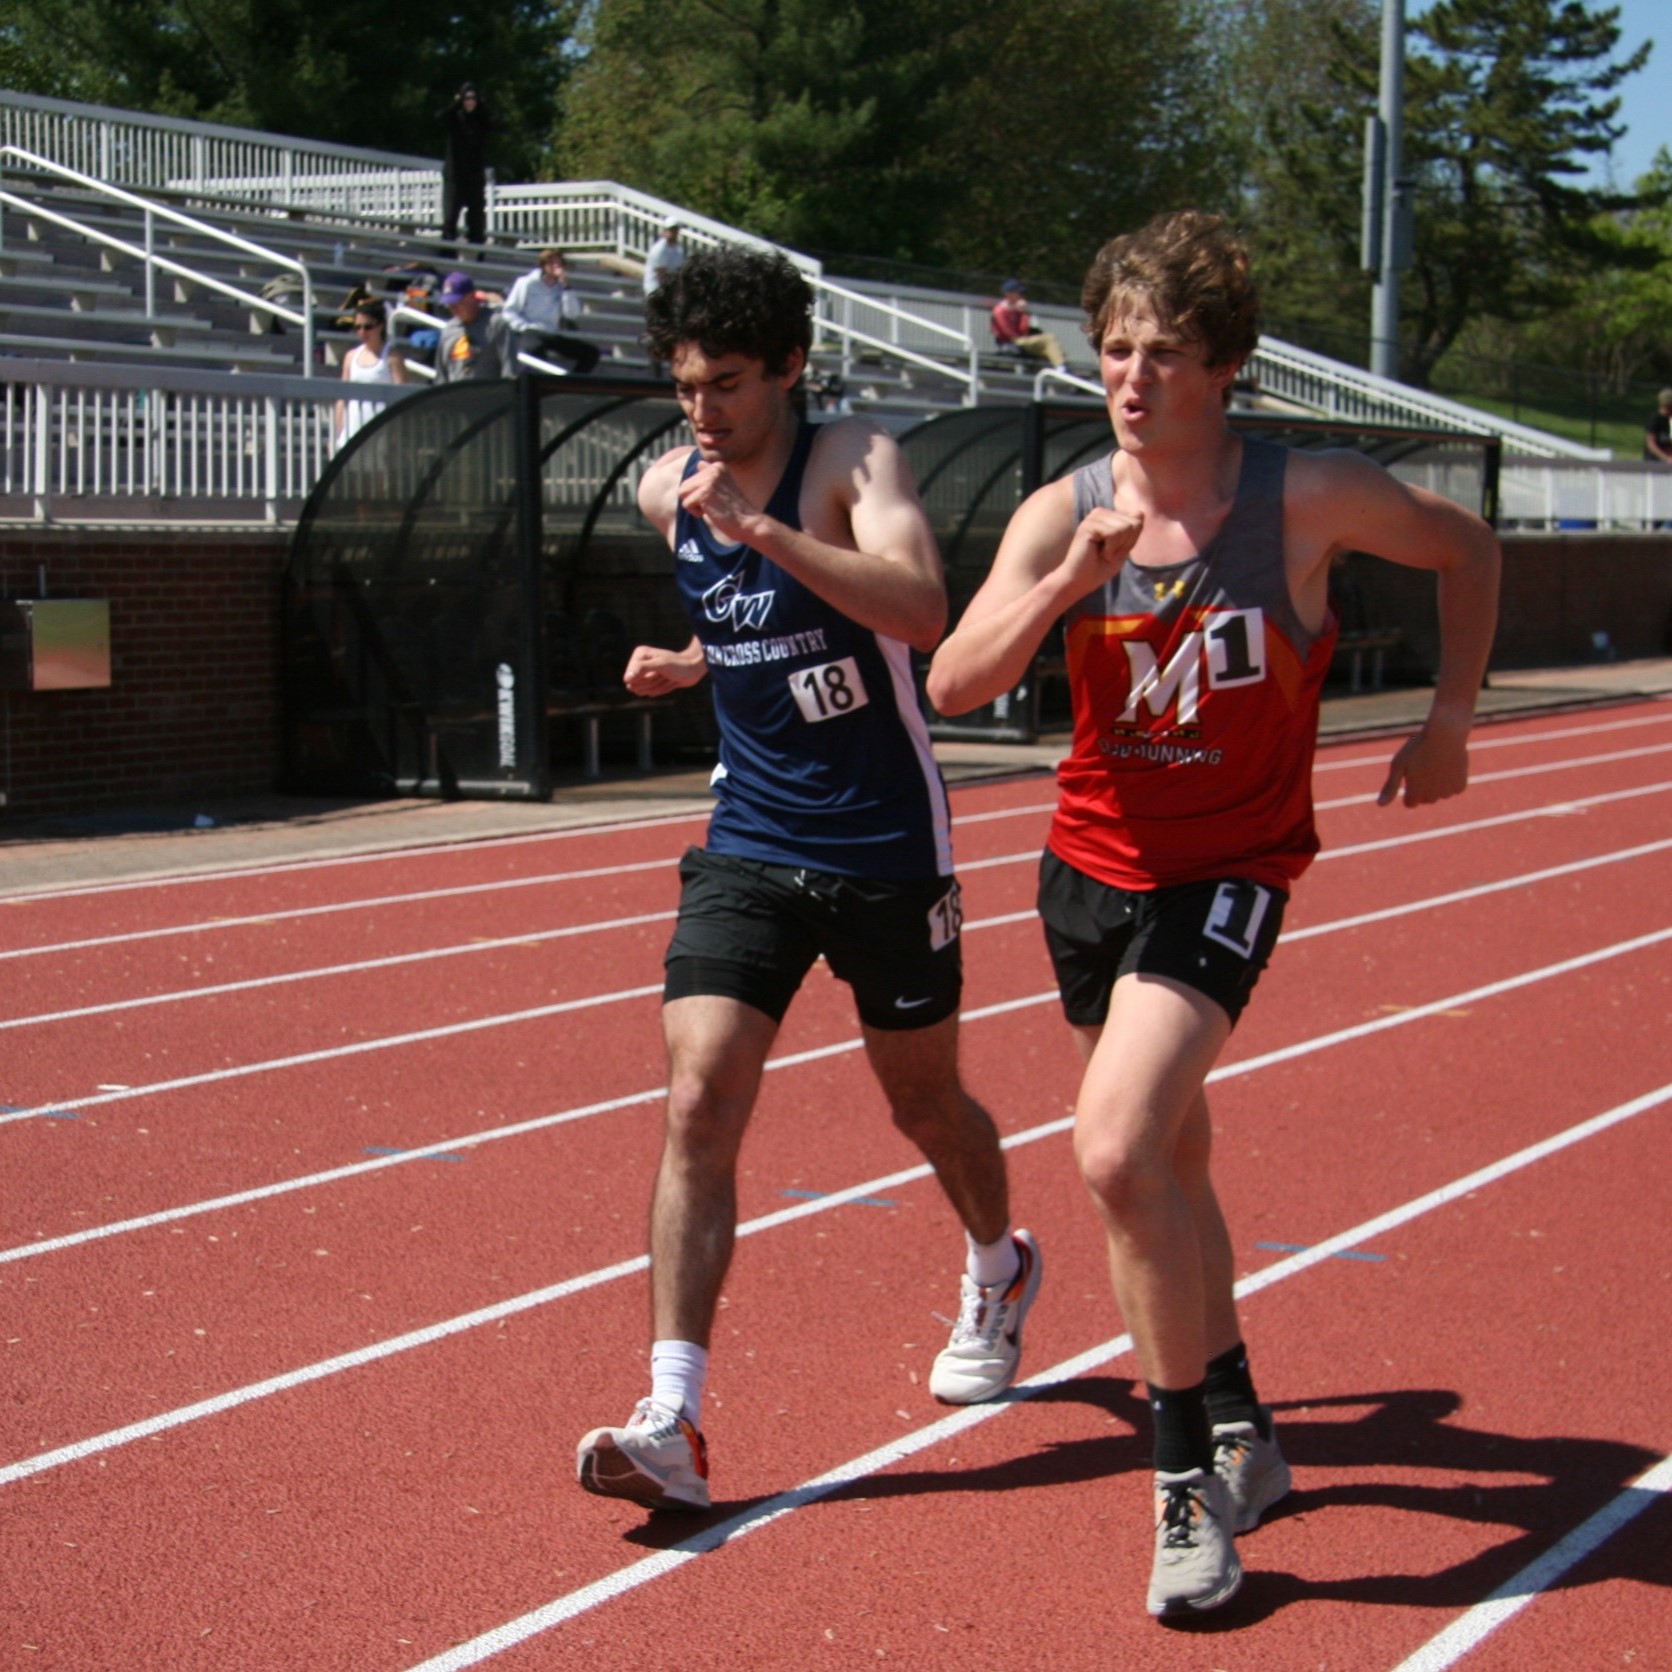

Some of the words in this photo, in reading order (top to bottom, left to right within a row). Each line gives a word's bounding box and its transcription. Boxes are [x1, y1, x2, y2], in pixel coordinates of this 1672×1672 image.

[702, 569, 776, 633] GW
[722, 640, 762, 667] CROSS
[761, 628, 828, 662] COUNTRY
[1113, 630, 1202, 726] M
[1209, 614, 1261, 682] 1
[802, 664, 854, 716] 18
[935, 889, 964, 942] 18
[1211, 882, 1260, 952] 1
